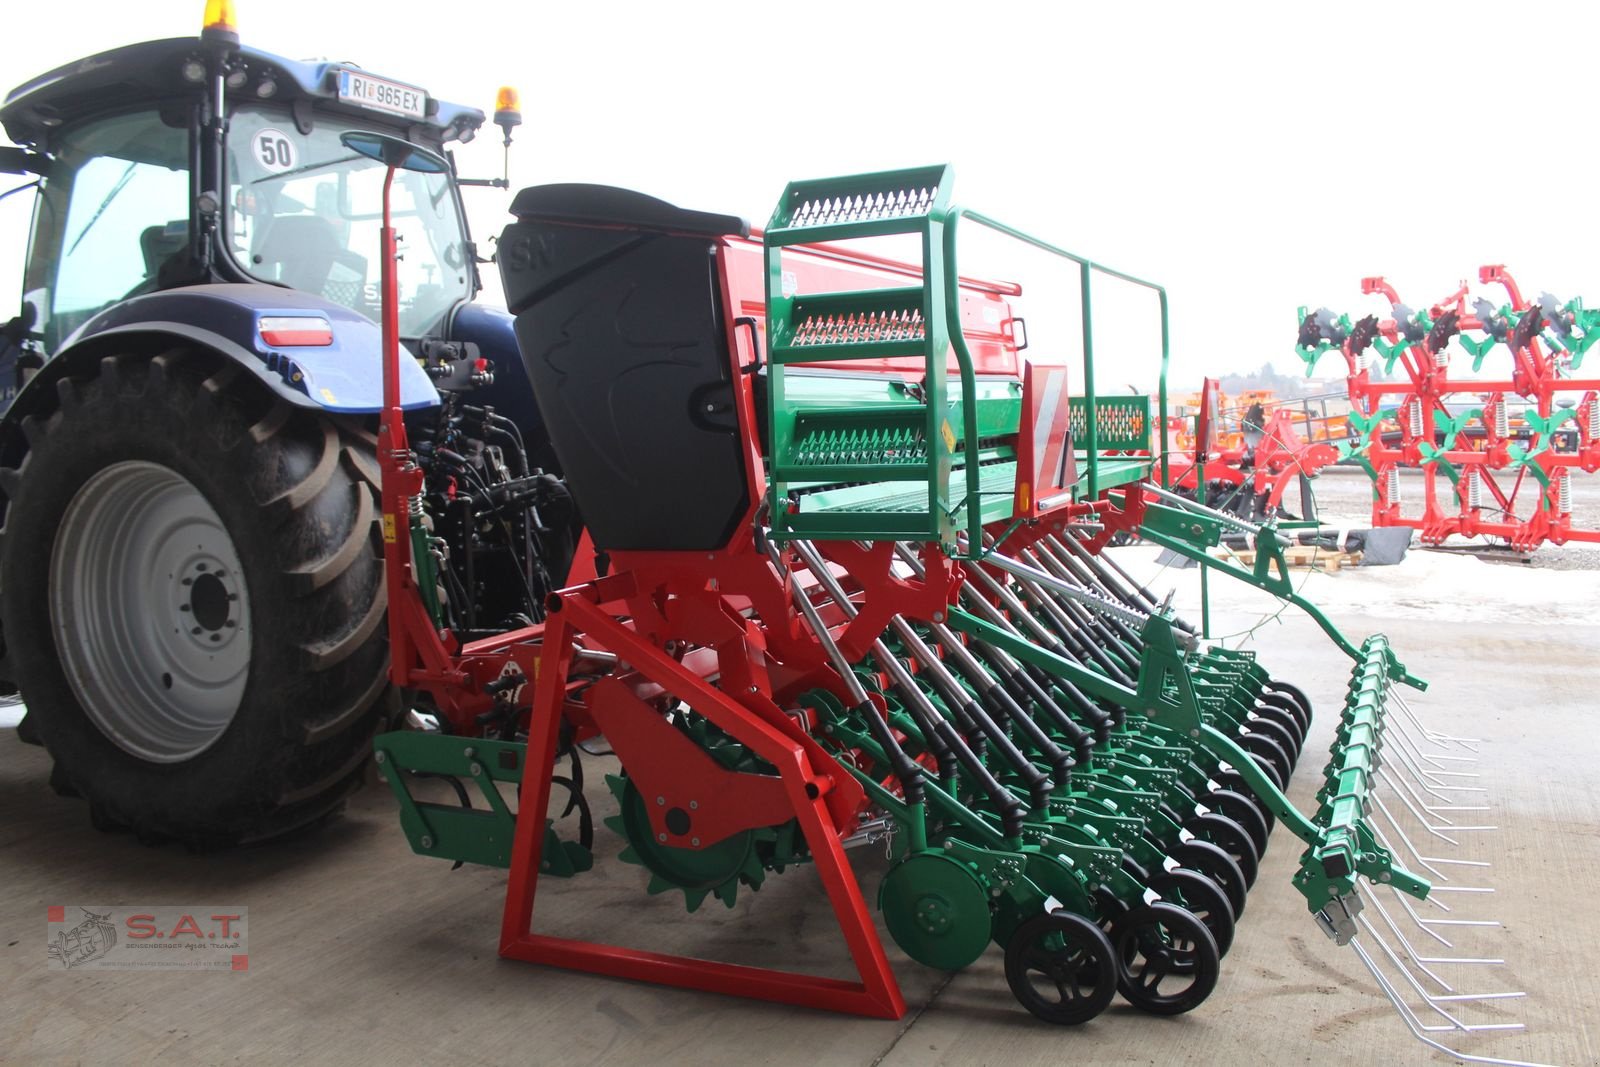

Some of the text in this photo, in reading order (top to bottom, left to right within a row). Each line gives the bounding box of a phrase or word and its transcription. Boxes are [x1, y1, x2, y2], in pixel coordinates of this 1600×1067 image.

[353, 78, 419, 112] RI 965 EX
[260, 136, 291, 167] 50
